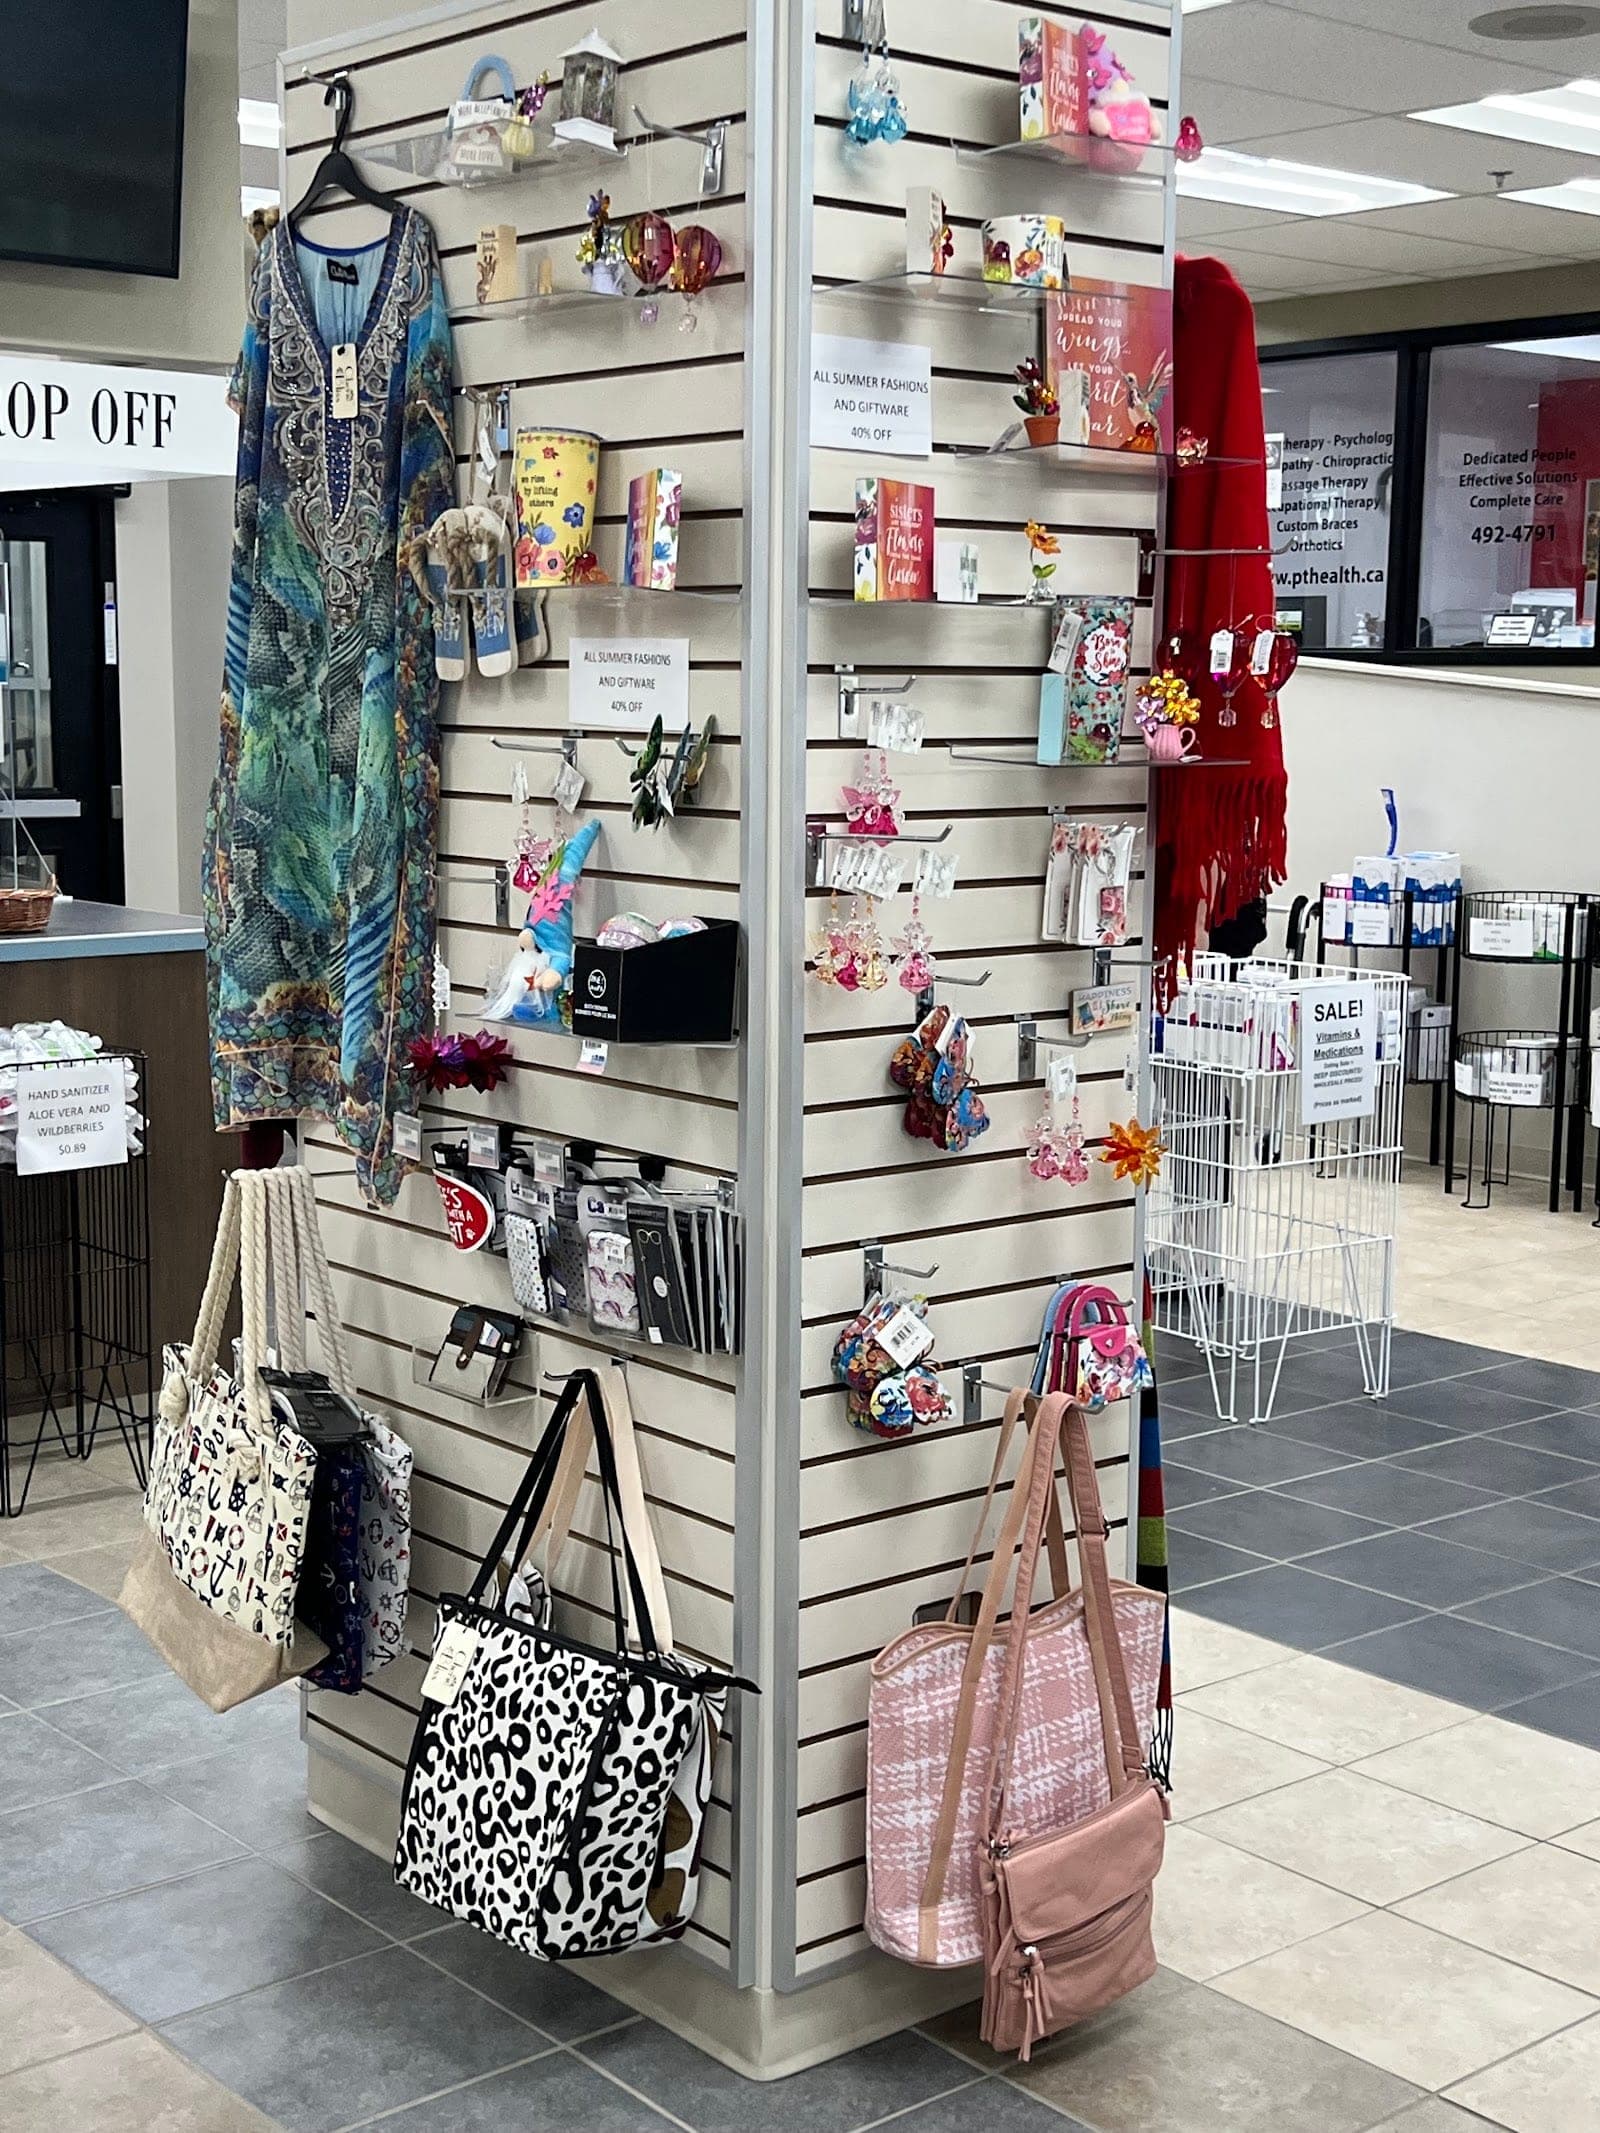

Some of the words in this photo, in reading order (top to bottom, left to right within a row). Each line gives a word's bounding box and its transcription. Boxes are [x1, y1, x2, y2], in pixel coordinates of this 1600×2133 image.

[1098, 317, 1123, 329] YOUR
[1089, 364, 1114, 375] YOUR
[813, 370, 831, 384] ALL
[833, 372, 879, 389] SUMMER
[880, 377, 930, 395] FASHIONS
[0, 381, 69, 440] OP
[91, 387, 177, 449] OFF
[833, 399, 856, 413] AND
[858, 401, 910, 418] GIFTWARE
[851, 426, 872, 440] 40%
[873, 428, 893, 441] OFF
[1322, 452, 1395, 469] Chiropractic
[1463, 449, 1529, 466] Dedicated
[1531, 447, 1577, 464] People
[1281, 479, 1319, 494] assage
[1321, 476, 1369, 490] Therapy
[1459, 473, 1514, 488] Effective
[1516, 471, 1578, 485] Solutions
[1334, 496, 1381, 510] Therapy
[1470, 494, 1532, 511] Complete
[1534, 493, 1564, 506] Care
[1276, 520, 1319, 533] Custom
[1321, 518, 1359, 531] Braces
[1471, 524, 1556, 544] 492-4791
[1290, 539, 1344, 552] Orthotics
[583, 651, 597, 663] ALL
[598, 652, 633, 665] SUMMER
[634, 653, 671, 667] FASHIONS
[599, 676, 616, 688] AND
[617, 677, 656, 690] GIFTWARE
[611, 700, 628, 712] 40%
[628, 701, 644, 713] OFF
[1314, 999, 1363, 1023] SALE!
[1316, 1031, 1353, 1044] Vitamins
[1314, 1045, 1364, 1060] Medications
[28, 1090, 59, 1101] HAND
[61, 1084, 110, 1099] SANITIZER
[28, 1108, 57, 1121] ALOE
[58, 1107, 85, 1119] VERA
[88, 1103, 111, 1114] AND
[37, 1121, 105, 1138] WILDBERRIES
[58, 1143, 87, 1156] $0.89
